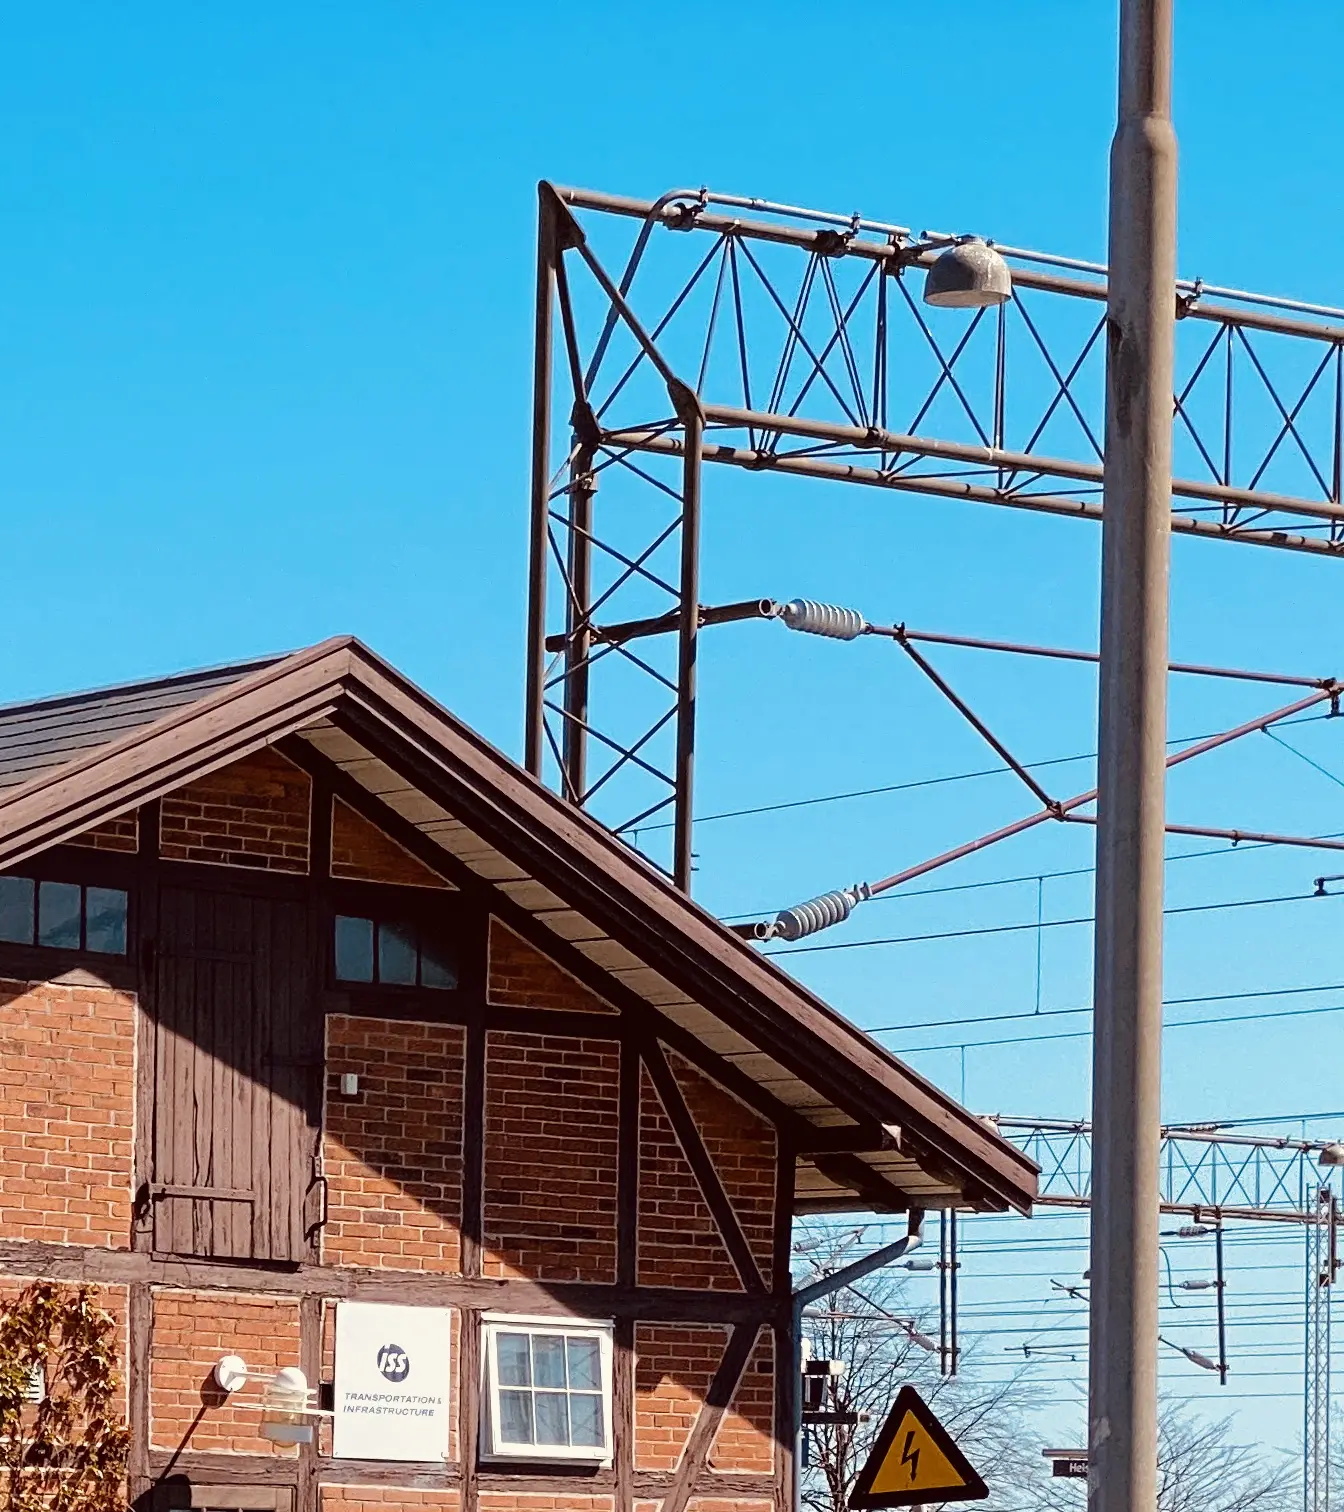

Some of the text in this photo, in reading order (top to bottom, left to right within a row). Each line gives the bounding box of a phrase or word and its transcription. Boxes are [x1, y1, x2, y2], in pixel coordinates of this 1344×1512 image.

[379, 1344, 407, 1373] ISS
[345, 1392, 436, 1404] TRANSPORTATION
[343, 1405, 435, 1417] INFRASTRUCTURE
